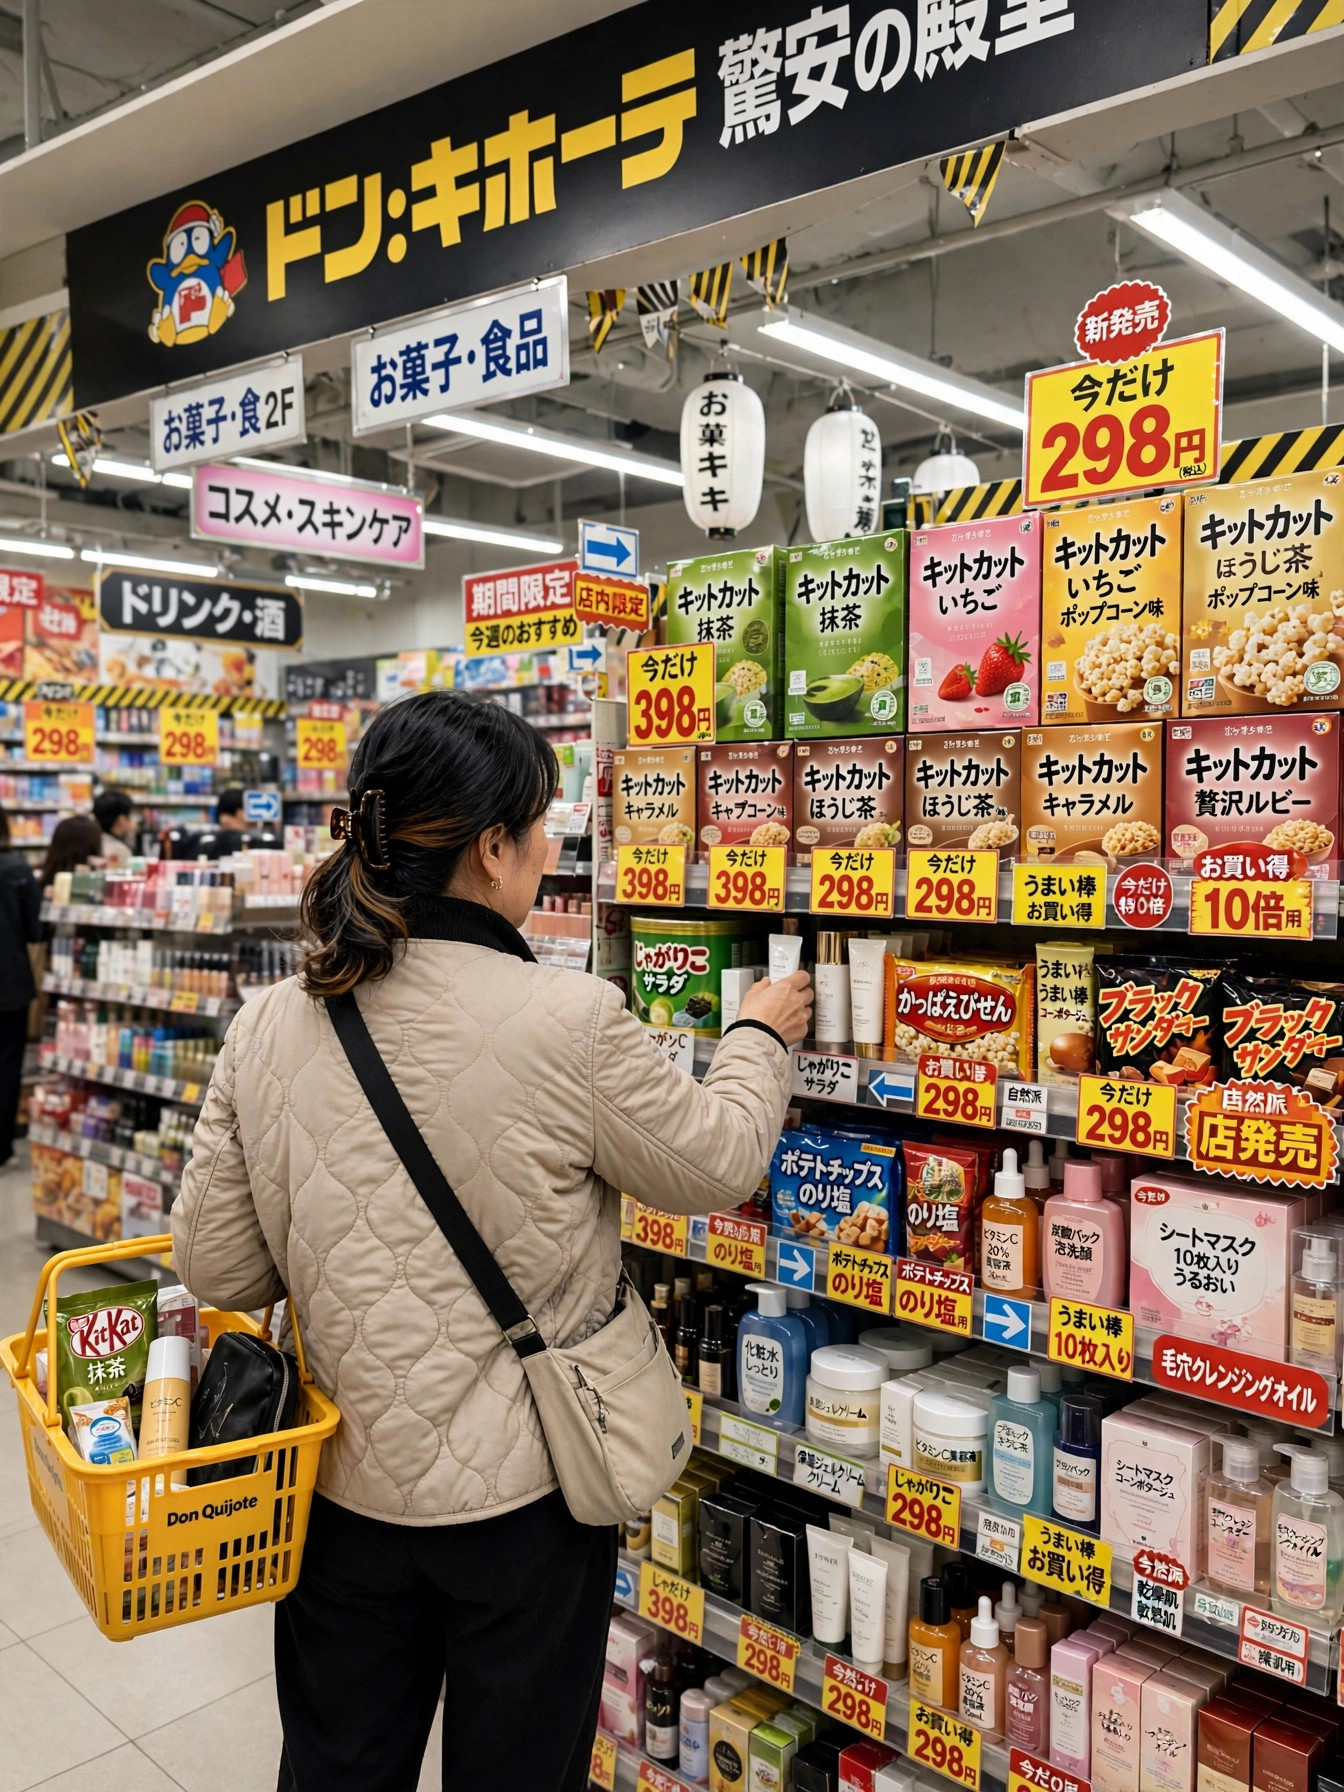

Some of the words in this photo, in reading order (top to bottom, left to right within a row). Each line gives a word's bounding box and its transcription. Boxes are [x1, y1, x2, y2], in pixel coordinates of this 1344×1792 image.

[1085, 300, 1160, 343] 新発売
[370, 308, 548, 408] お菓子・食品
[1070, 358, 1175, 412] 今だけ
[1040, 404, 1206, 493] 298円
[208, 485, 411, 548] コスメ・スキンケア
[1200, 499, 1333, 550] キットカット
[1054, 524, 1167, 570] キットカット
[1216, 543, 1313, 579] ほうじ茶
[922, 546, 1025, 588] キットカット
[1067, 564, 1142, 599] いちご
[471, 569, 571, 617] 期間限定
[678, 578, 760, 615] キットカット
[798, 564, 890, 605] キットカット
[939, 584, 1002, 615] いちご
[1207, 579, 1320, 609] ポップコーン味
[122, 581, 286, 640] ドリンク・酒
[578, 587, 644, 617] 店内限定
[820, 603, 862, 633] 抹茶
[1060, 597, 1164, 627] ポップコーン味
[470, 615, 577, 650] 今週のおすすめ
[697, 616, 735, 642] 抹茶
[641, 651, 698, 682] 今だけ
[634, 685, 711, 739] 398円
[804, 762, 891, 792] キットカット
[916, 758, 1009, 789] キットカット
[1038, 752, 1148, 787] キットカット
[1185, 746, 1318, 783] キットカット
[621, 773, 686, 797] キットカット
[708, 769, 782, 796] キットカット
[624, 802, 679, 820] キャラメル
[810, 796, 876, 820] ほうじ茶
[923, 793, 994, 818] ほうじ茶
[1043, 793, 1134, 817] キャラメル
[1195, 789, 1312, 817] 贅沢ルビー
[632, 848, 668, 865] 今だけ
[726, 850, 766, 867] 今だけ
[830, 853, 874, 871] 今だけ
[927, 854, 976, 874] 今だけ
[1201, 855, 1290, 879] お買い得
[622, 867, 680, 901] 398円
[715, 870, 780, 906] 398円
[818, 874, 888, 911] 298円
[915, 877, 992, 916] 298円
[1024, 875, 1096, 898] うまい棒
[1121, 877, 1167, 895] 今だけ
[1027, 902, 1093, 922] お買い得
[634, 942, 709, 974] じゃがりこ
[643, 973, 688, 994] サラダ
[1039, 985, 1088, 1006] うまい棒
[898, 987, 1012, 1023] かっぱえびせん
[1099, 978, 1204, 1027] ブラック
[1223, 997, 1336, 1048] ブラック
[797, 1056, 852, 1079] じゃがりこ
[804, 1078, 839, 1095] サラダ
[923, 1083, 992, 1123] 298円
[1099, 1082, 1152, 1107] 今だけ
[1086, 1104, 1169, 1152] 298円
[1200, 1113, 1321, 1169] 店発売
[781, 1150, 884, 1190] ポテトチップス
[800, 1183, 852, 1213] のり塩
[637, 1215, 684, 1253] 398円
[907, 1202, 959, 1232] のり塩
[983, 1228, 1019, 1246] ビタミンC
[988, 1246, 1010, 1259] 20%
[1159, 1222, 1257, 1257] シートマスク
[831, 1250, 889, 1279] ポテトチップス
[901, 1263, 970, 1294] ポテトチップス
[1174, 1247, 1239, 1276] 10枚入り
[831, 1273, 883, 1307] のり塩
[1174, 1268, 1236, 1294] うるおい
[899, 1289, 968, 1330] のり塩用
[1058, 1304, 1123, 1339] うまい棒
[80, 1310, 139, 1358] KitKat
[745, 1340, 780, 1363] 化粧水
[1054, 1331, 1131, 1373] 10枚入り
[87, 1357, 127, 1386] 抹茶
[746, 1359, 779, 1379] しっとり
[1161, 1348, 1317, 1414] 毛穴クレンジングオイル
[807, 1471, 841, 1495] クリーム
[895, 1469, 954, 1505] じゃがりこ
[1116, 1459, 1174, 1486] シートマスク
[167, 1509, 199, 1527] Don
[201, 1495, 258, 1522] Quijote
[891, 1492, 955, 1544] 298円
[1040, 1526, 1096, 1560] うまい棒
[1028, 1546, 1106, 1595] お買い得
[647, 1590, 699, 1639] 398円
[744, 1643, 790, 1687] 298円
[827, 1684, 882, 1737] 298円
[914, 1728, 977, 1786] 298円
